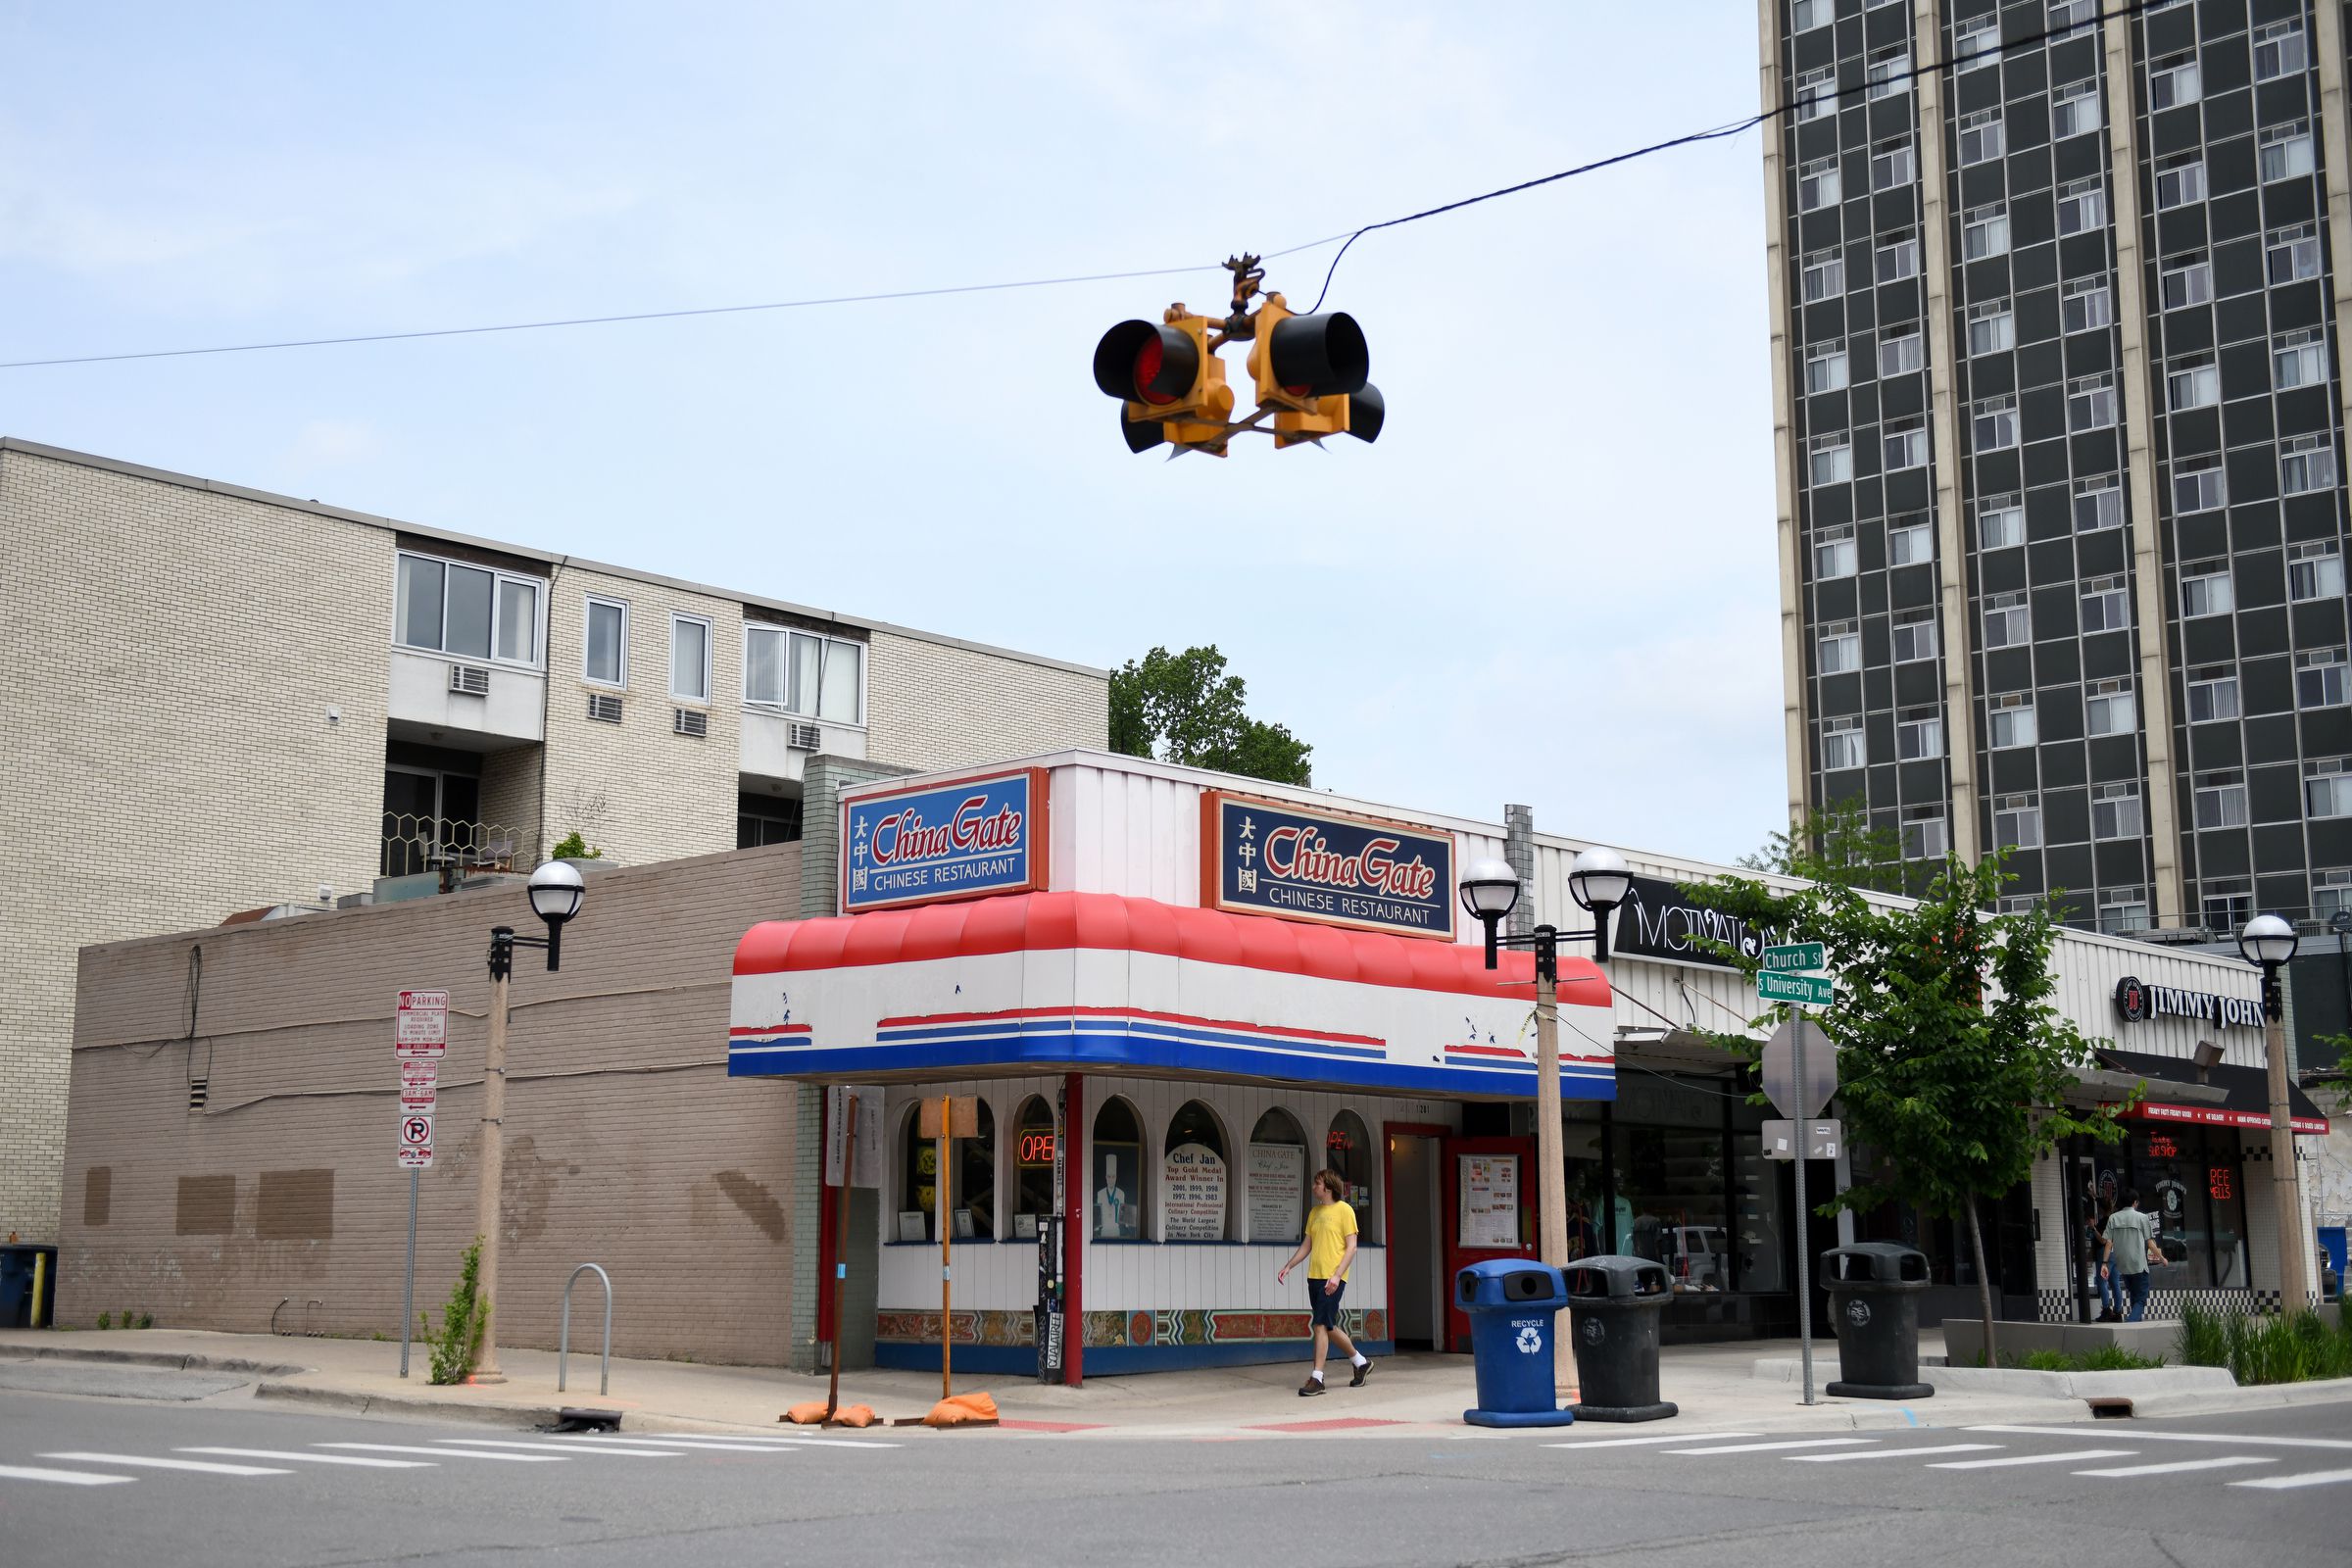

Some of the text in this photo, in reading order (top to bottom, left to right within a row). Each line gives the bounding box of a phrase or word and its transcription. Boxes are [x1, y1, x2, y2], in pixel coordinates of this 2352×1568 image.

[872, 795, 1022, 866] China Gate
[853, 815, 868, 893] 大中國
[1238, 815, 1257, 895] 大中國
[1264, 826, 1436, 899] China Gate
[874, 858, 1015, 891] CHINESE RESTAURANT
[1269, 888, 1429, 924] CHINESE RESTAURANT
[1765, 950, 1822, 968] Church St
[399, 995, 446, 1007] NO PARKING
[1759, 976, 1832, 1001] S University Ave
[2149, 985, 2214, 1019] JIMMY
[2219, 997, 2265, 1029] JOHN
[1173, 1152, 1215, 1165] Chef Jan
[2210, 1168, 2230, 1187] REE
[1049, 1312, 1061, 1368] COALATREE
[1511, 1319, 1544, 1328] RECYCLE
